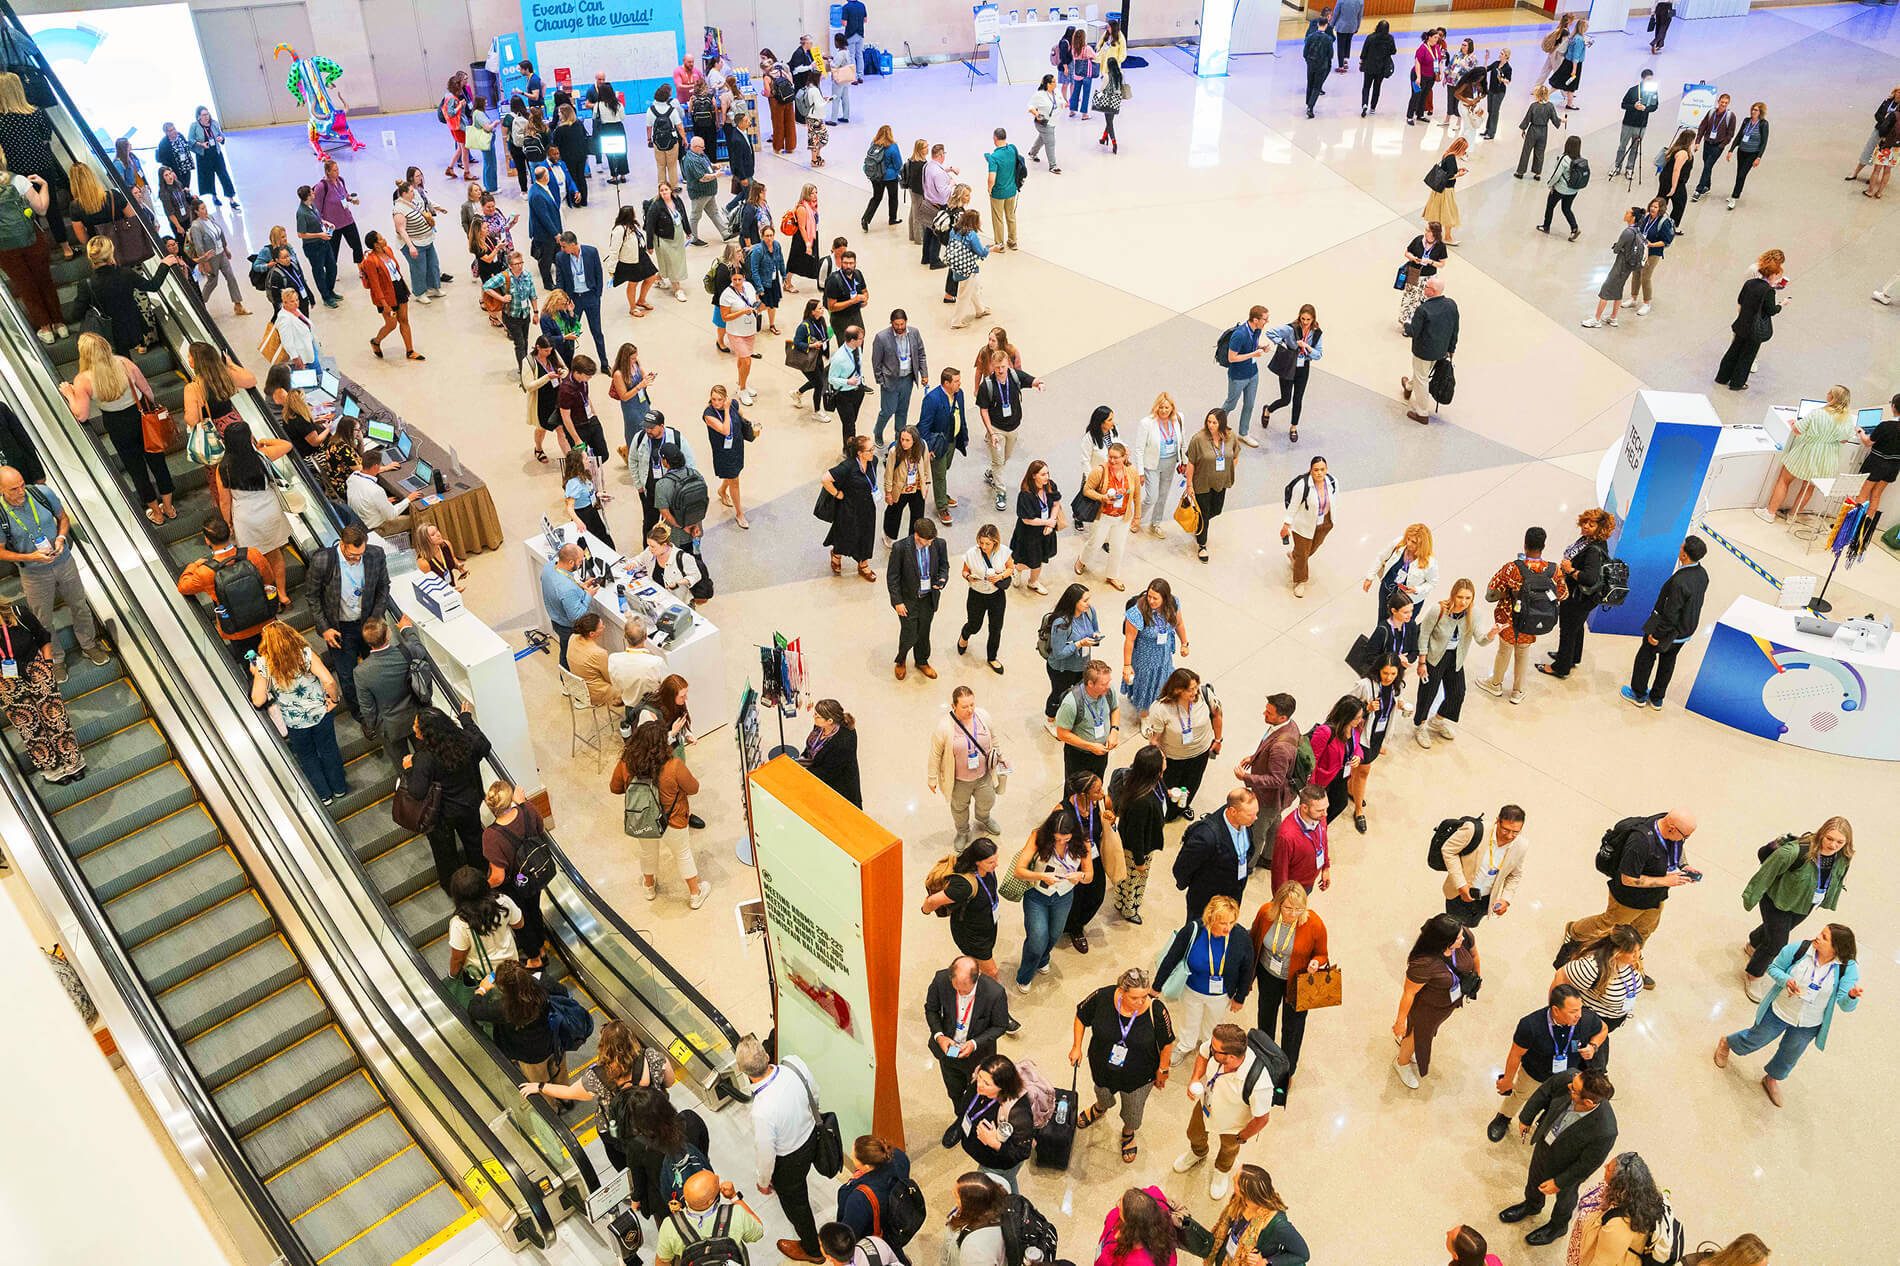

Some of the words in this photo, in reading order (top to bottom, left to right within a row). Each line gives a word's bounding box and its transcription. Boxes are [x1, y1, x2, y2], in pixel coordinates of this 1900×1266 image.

[532, 3, 575, 17] Events
[578, 0, 604, 13] Can
[534, 16, 584, 33] Change
[586, 14, 607, 27] the
[610, 8, 653, 25] World!
[1625, 441, 1639, 470] HELP
[1630, 424, 1644, 458] TECH
[763, 881, 791, 909] MEETING
[791, 905, 815, 929] ROOMS
[765, 891, 792, 919] MEETING
[793, 915, 816, 939] ROOMS
[766, 901, 786, 922] STARS
[786, 918, 794, 929] AT
[794, 924, 814, 946] NIGHT
[815, 942, 850, 976] BALLROOM
[768, 910, 801, 944] HEMISFAIR
[802, 939, 836, 973] BALLROOM
